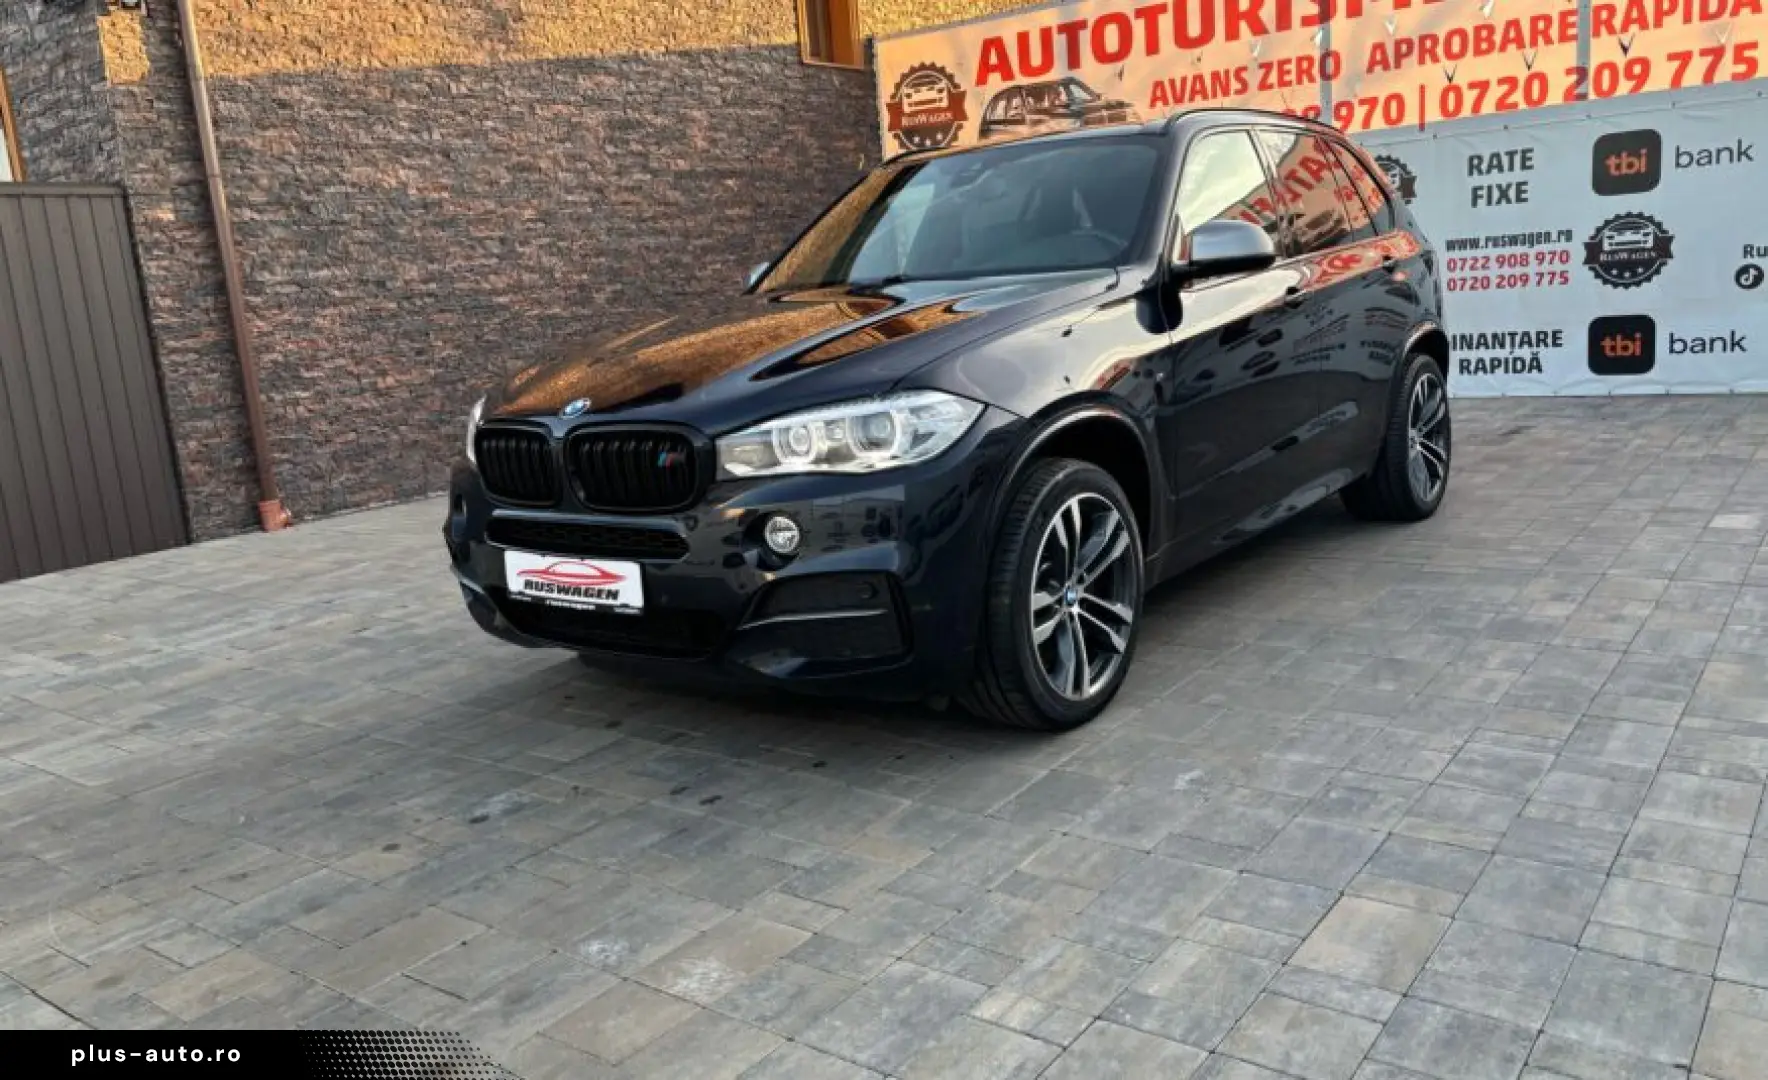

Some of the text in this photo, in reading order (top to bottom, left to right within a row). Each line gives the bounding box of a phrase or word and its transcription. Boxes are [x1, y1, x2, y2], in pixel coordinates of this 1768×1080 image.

[974, 0, 1445, 87] AUTOTURI
[1150, 66, 1248, 109] AVANS
[1257, 50, 1341, 91] ZERO
[1366, 9, 1578, 74] APROBARE
[1333, 93, 1405, 131] 970
[1439, 71, 1549, 119] 0720
[1563, 56, 1651, 103] 209
[1666, 41, 1759, 90] 775
[1467, 147, 1534, 177] RATE
[1605, 138, 1756, 176] tbi bank
[1470, 181, 1529, 208] FIXE
[1446, 230, 1573, 252] www.ruswagen.ro
[1446, 249, 1571, 272] 0722 908 970
[1446, 270, 1570, 292] 0720 209 775
[1601, 329, 1748, 358] tbi bank
[1459, 351, 1543, 375] RAPIDĂ
[524, 579, 620, 601] RUSWAGEN
